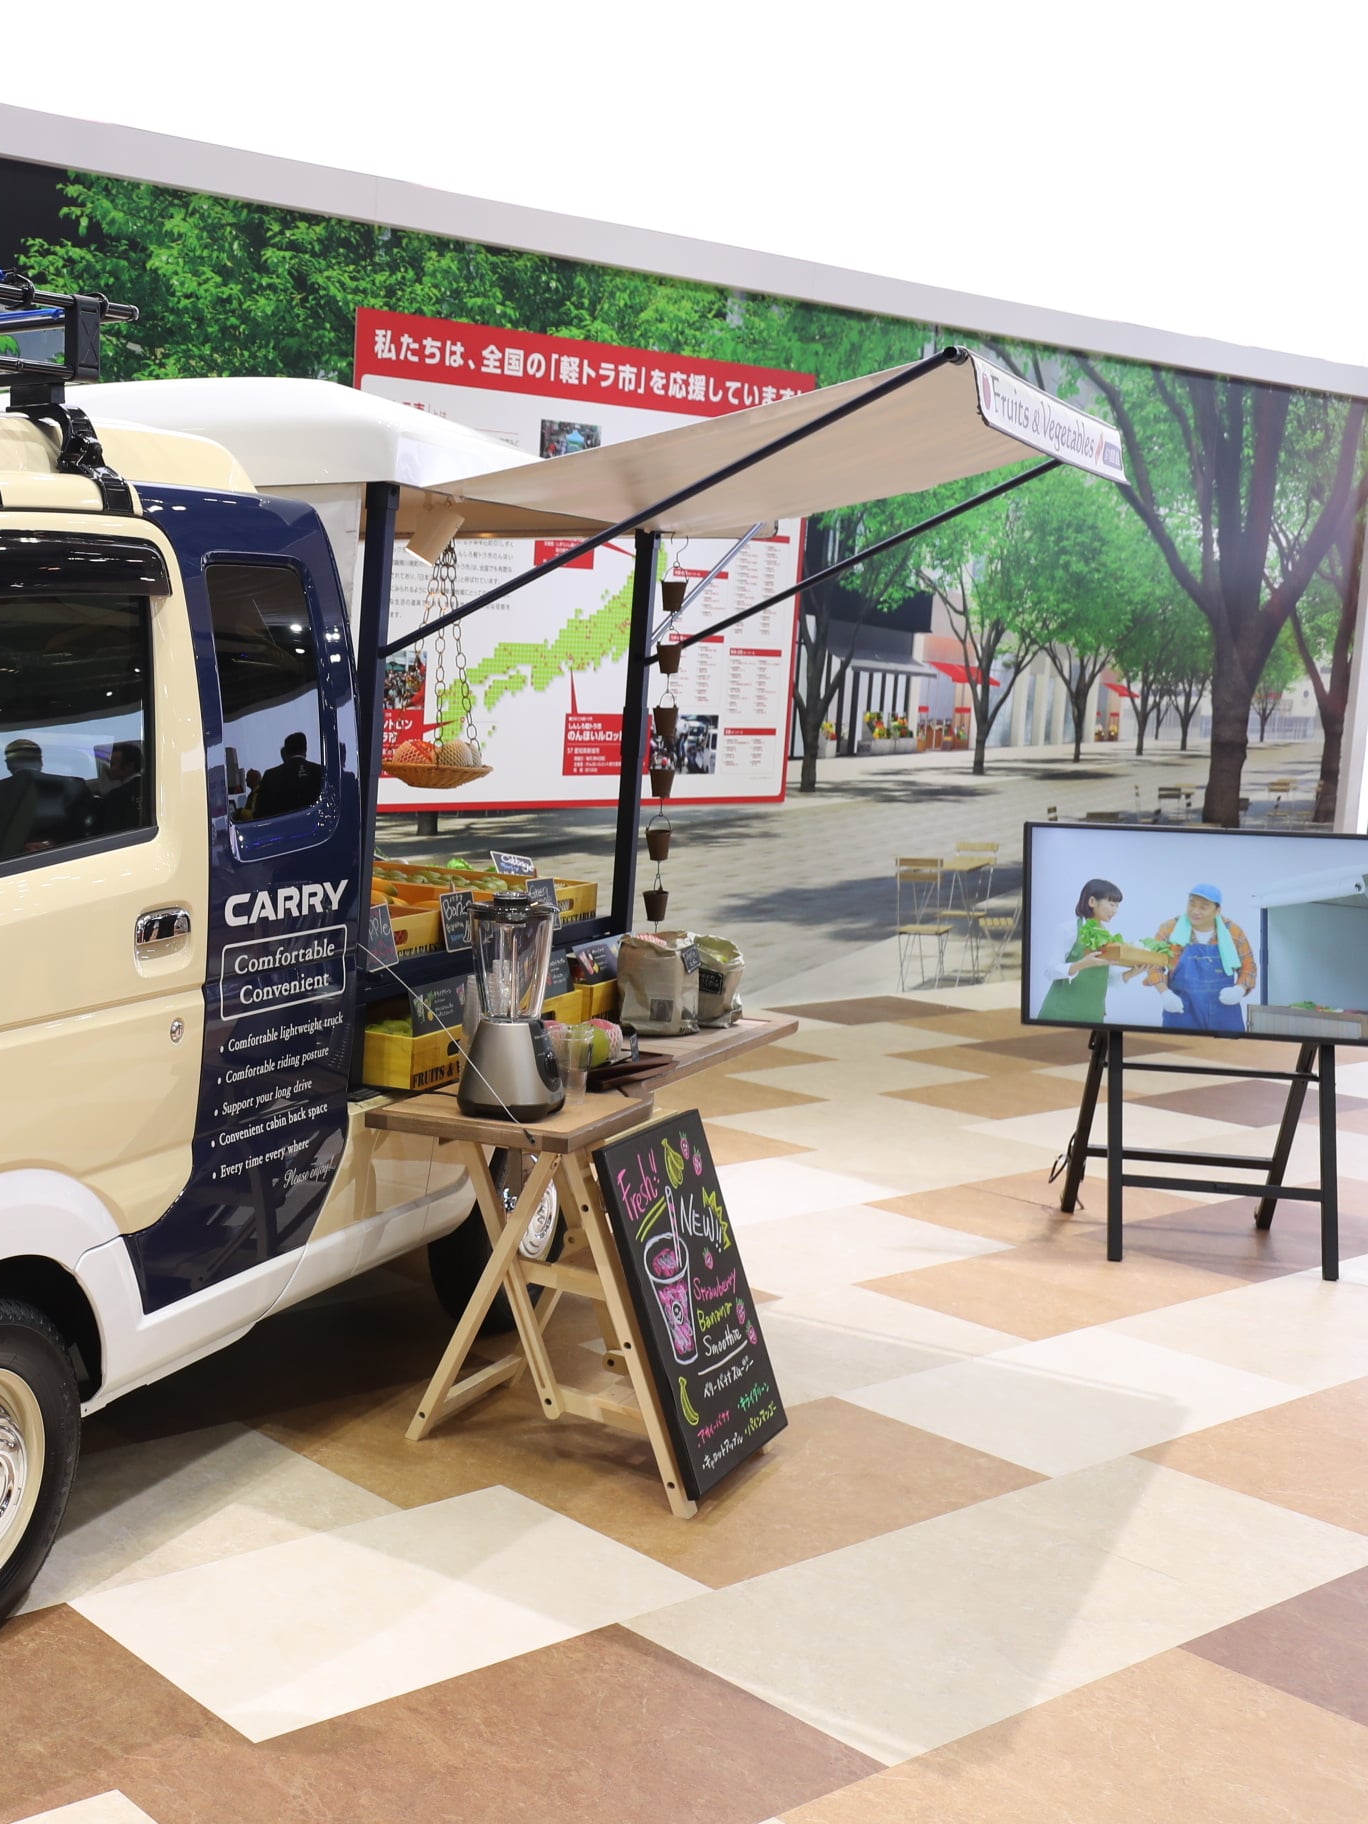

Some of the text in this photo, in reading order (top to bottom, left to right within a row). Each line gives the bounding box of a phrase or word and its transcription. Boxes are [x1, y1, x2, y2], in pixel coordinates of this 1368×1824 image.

[990, 375, 1030, 429] Fruits
[1032, 408, 1041, 436] &
[1040, 401, 1095, 459] Vegetables
[224, 879, 349, 927] CARRY
[235, 938, 335, 974] Comfortable
[240, 972, 329, 1004] Convenient
[228, 1011, 344, 1052] Comfortable lightweight truck
[225, 1047, 329, 1083] Comfortable riding posture
[413, 1065, 445, 1088] FRUITS
[222, 1079, 313, 1115] Support your long drive
[219, 1103, 328, 1146] Convenient cabin back space
[220, 1139, 310, 1178] Every time every where
[283, 1168, 309, 1189] Please
[680, 1193, 722, 1253] NEW!!
[693, 1267, 737, 1302] Strawberry
[696, 1302, 732, 1332] Banana
[703, 1323, 742, 1357] Smoothie
